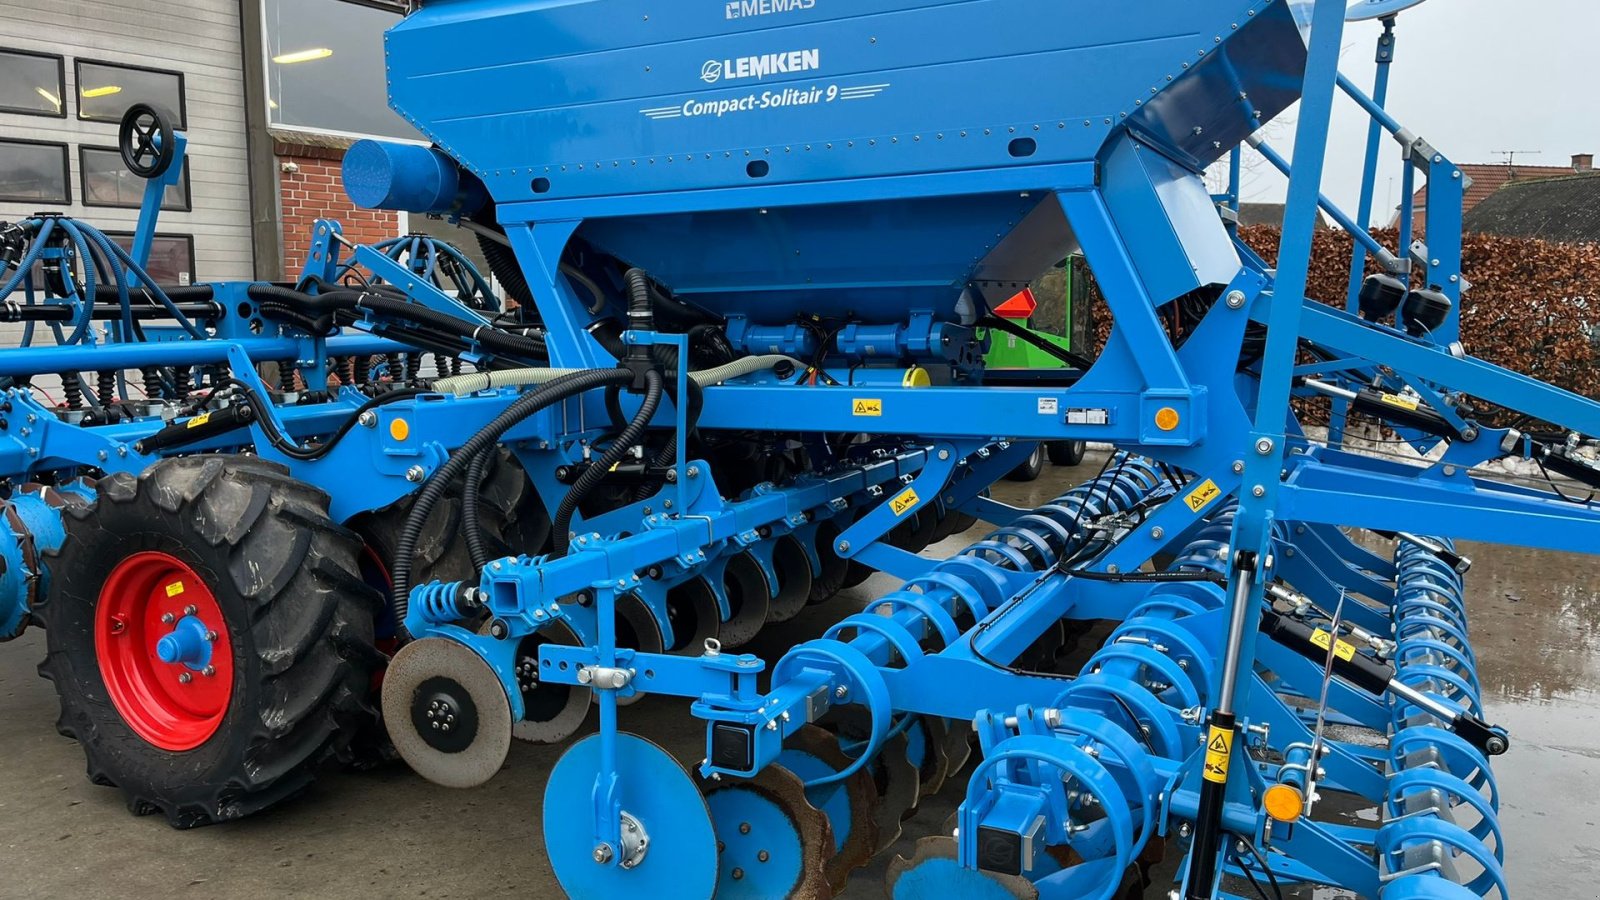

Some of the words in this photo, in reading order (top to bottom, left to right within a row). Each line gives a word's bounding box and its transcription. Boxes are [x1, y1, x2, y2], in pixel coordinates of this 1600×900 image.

[724, 48, 819, 80] LEMKEN
[682, 87, 822, 117] Compact-Solitair
[826, 84, 838, 103] 9
